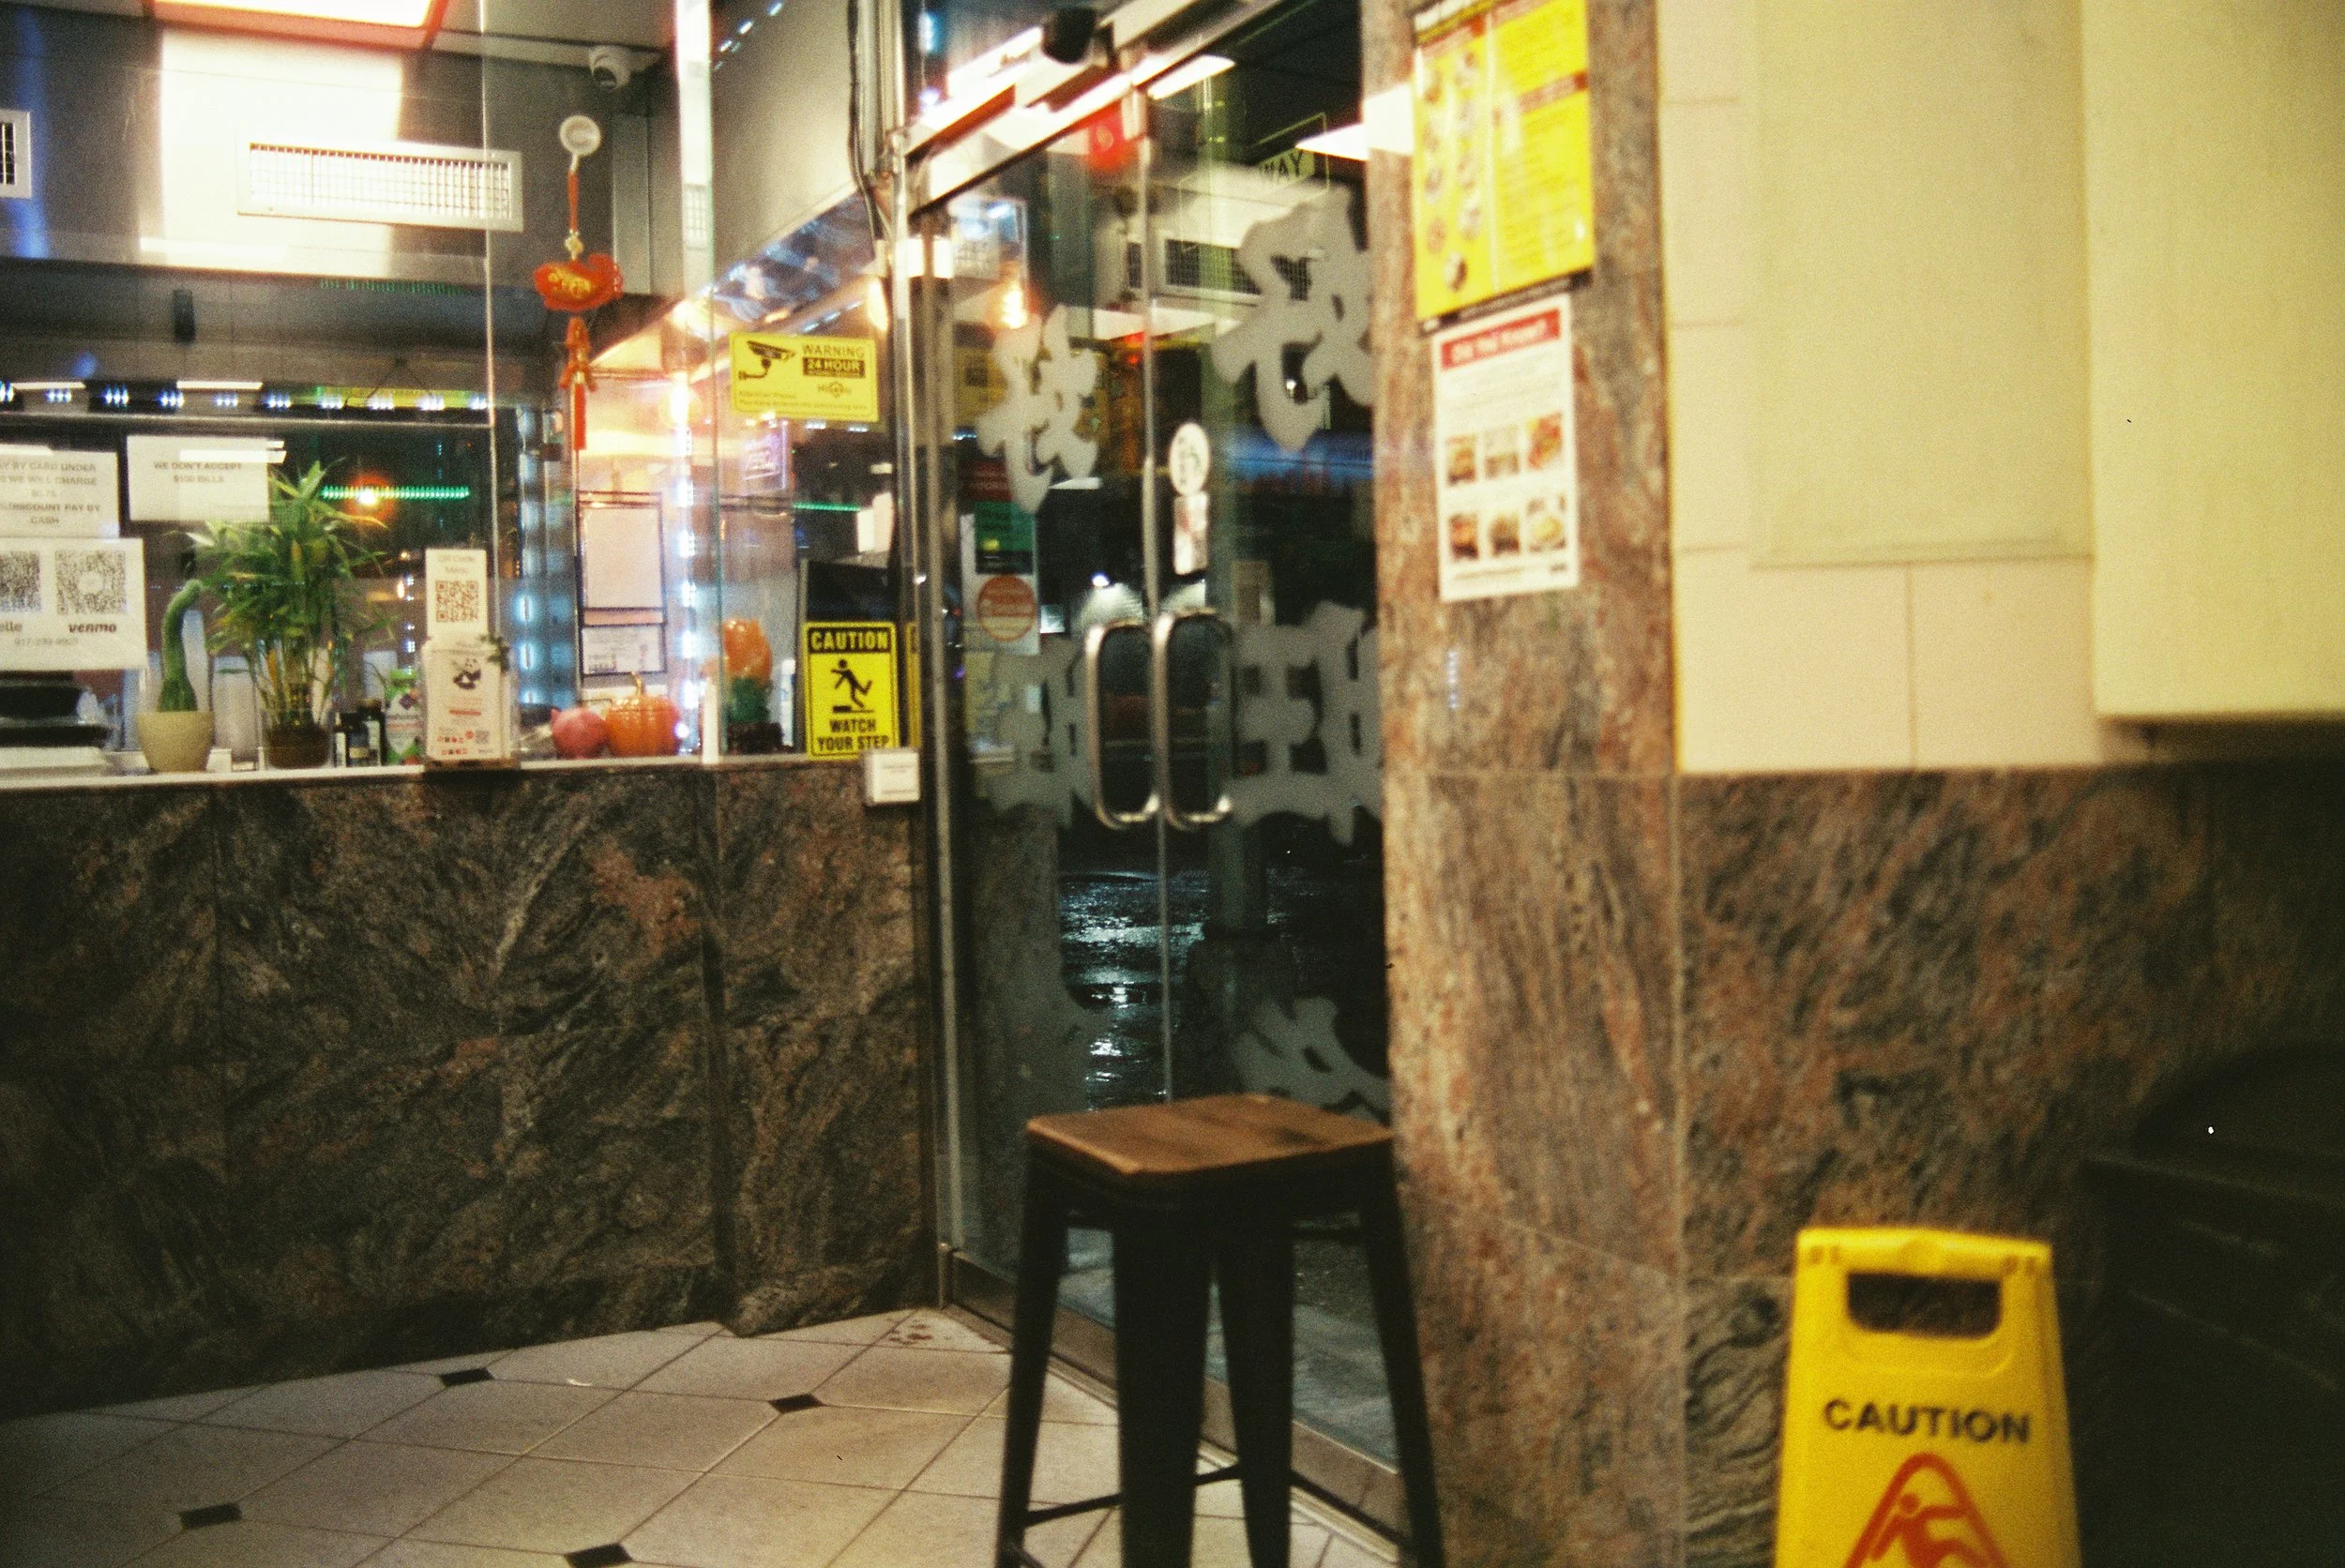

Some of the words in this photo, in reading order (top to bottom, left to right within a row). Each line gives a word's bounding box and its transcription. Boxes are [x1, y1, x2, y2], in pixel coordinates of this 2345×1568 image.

[802, 343, 865, 358] WARNING
[808, 359, 822, 369] 24
[825, 360, 860, 372] HOUR
[29, 460, 58, 471] CARD
[60, 462, 97, 473] UNDER
[153, 460, 169, 470] WE
[204, 461, 242, 471] ACCEPT
[54, 475, 97, 486] CHARGE
[65, 504, 83, 513] PAY
[30, 516, 59, 525] CASH
[68, 623, 117, 633] venmo
[810, 630, 889, 651] CAUTION
[829, 718, 877, 733] WATCH
[817, 736, 854, 751] YOUR
[857, 735, 890, 750] STEP
[1823, 1398, 2031, 1444] CAUTION
